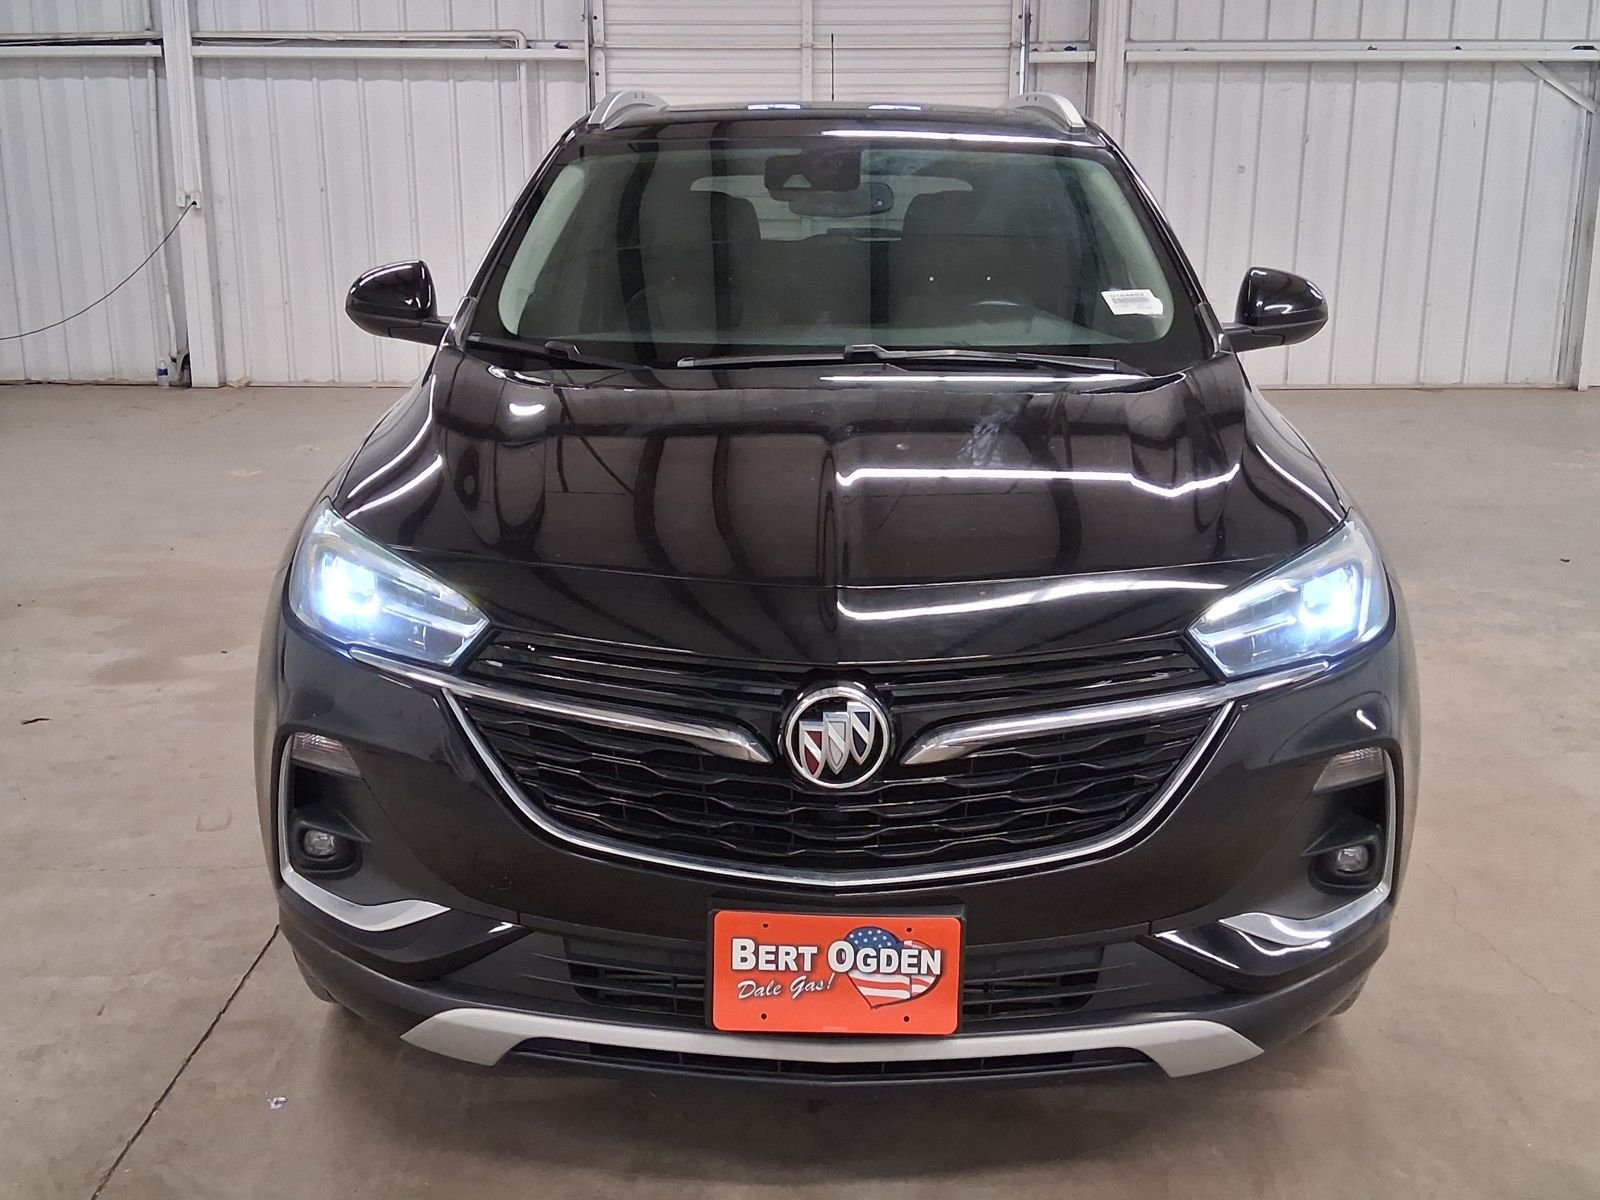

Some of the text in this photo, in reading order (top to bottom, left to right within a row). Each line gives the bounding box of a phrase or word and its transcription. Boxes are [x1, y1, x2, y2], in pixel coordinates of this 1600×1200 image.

[731, 937, 943, 975] BERT OGDEN
[737, 972, 835, 1000] Dale Gas!
